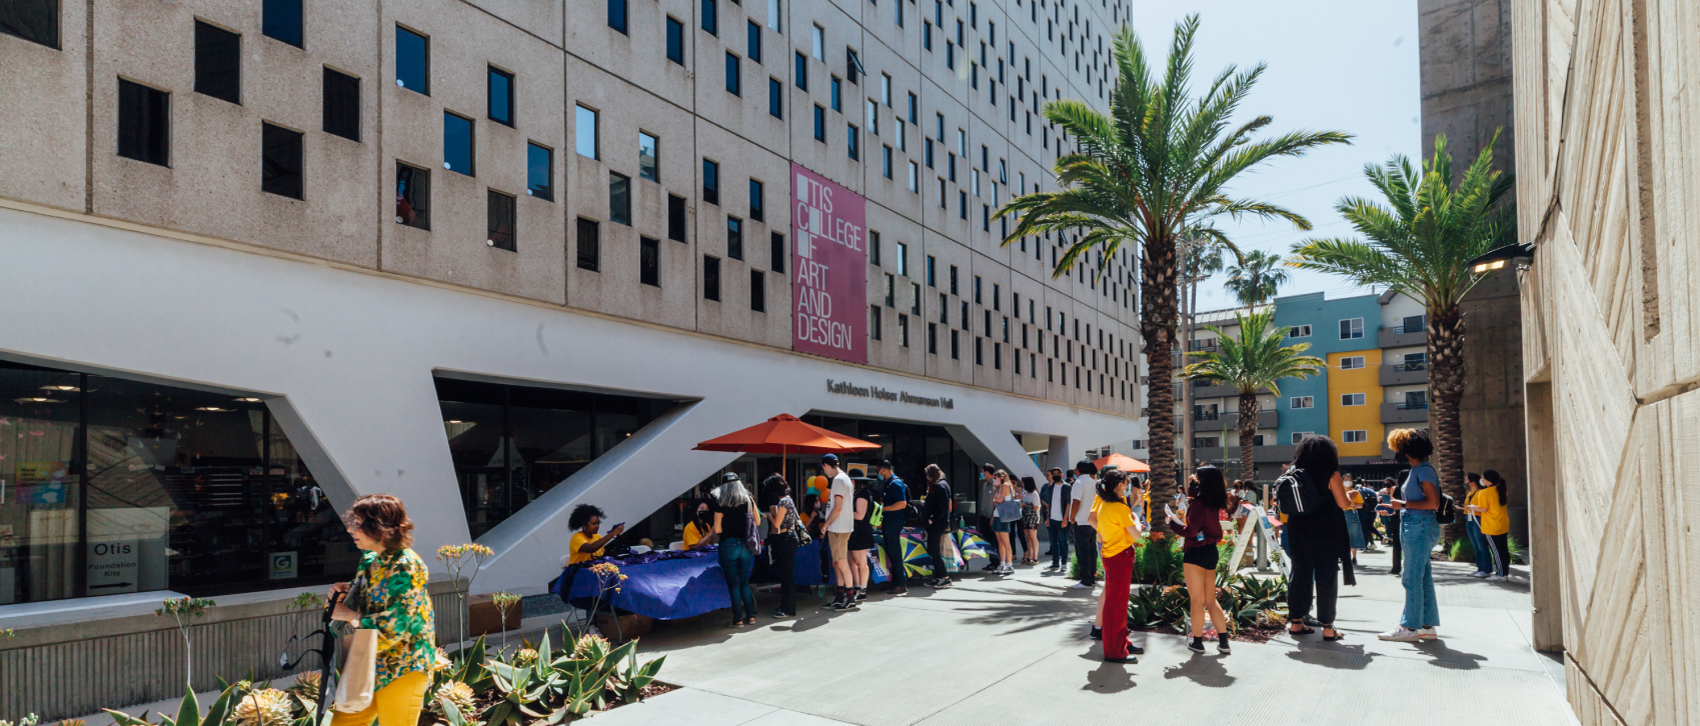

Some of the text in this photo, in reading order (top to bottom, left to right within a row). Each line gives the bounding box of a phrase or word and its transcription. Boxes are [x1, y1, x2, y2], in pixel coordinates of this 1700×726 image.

[797, 173, 833, 214] TIS
[797, 201, 861, 252] CLLEGE
[797, 258, 829, 291] ART
[797, 285, 832, 319] AND
[798, 312, 852, 351] DESIGN
[826, 379, 954, 410] Kathleen Holser Ahmanson Hall
[88, 562, 137, 570] Foundation
[94, 543, 131, 556] Otis
